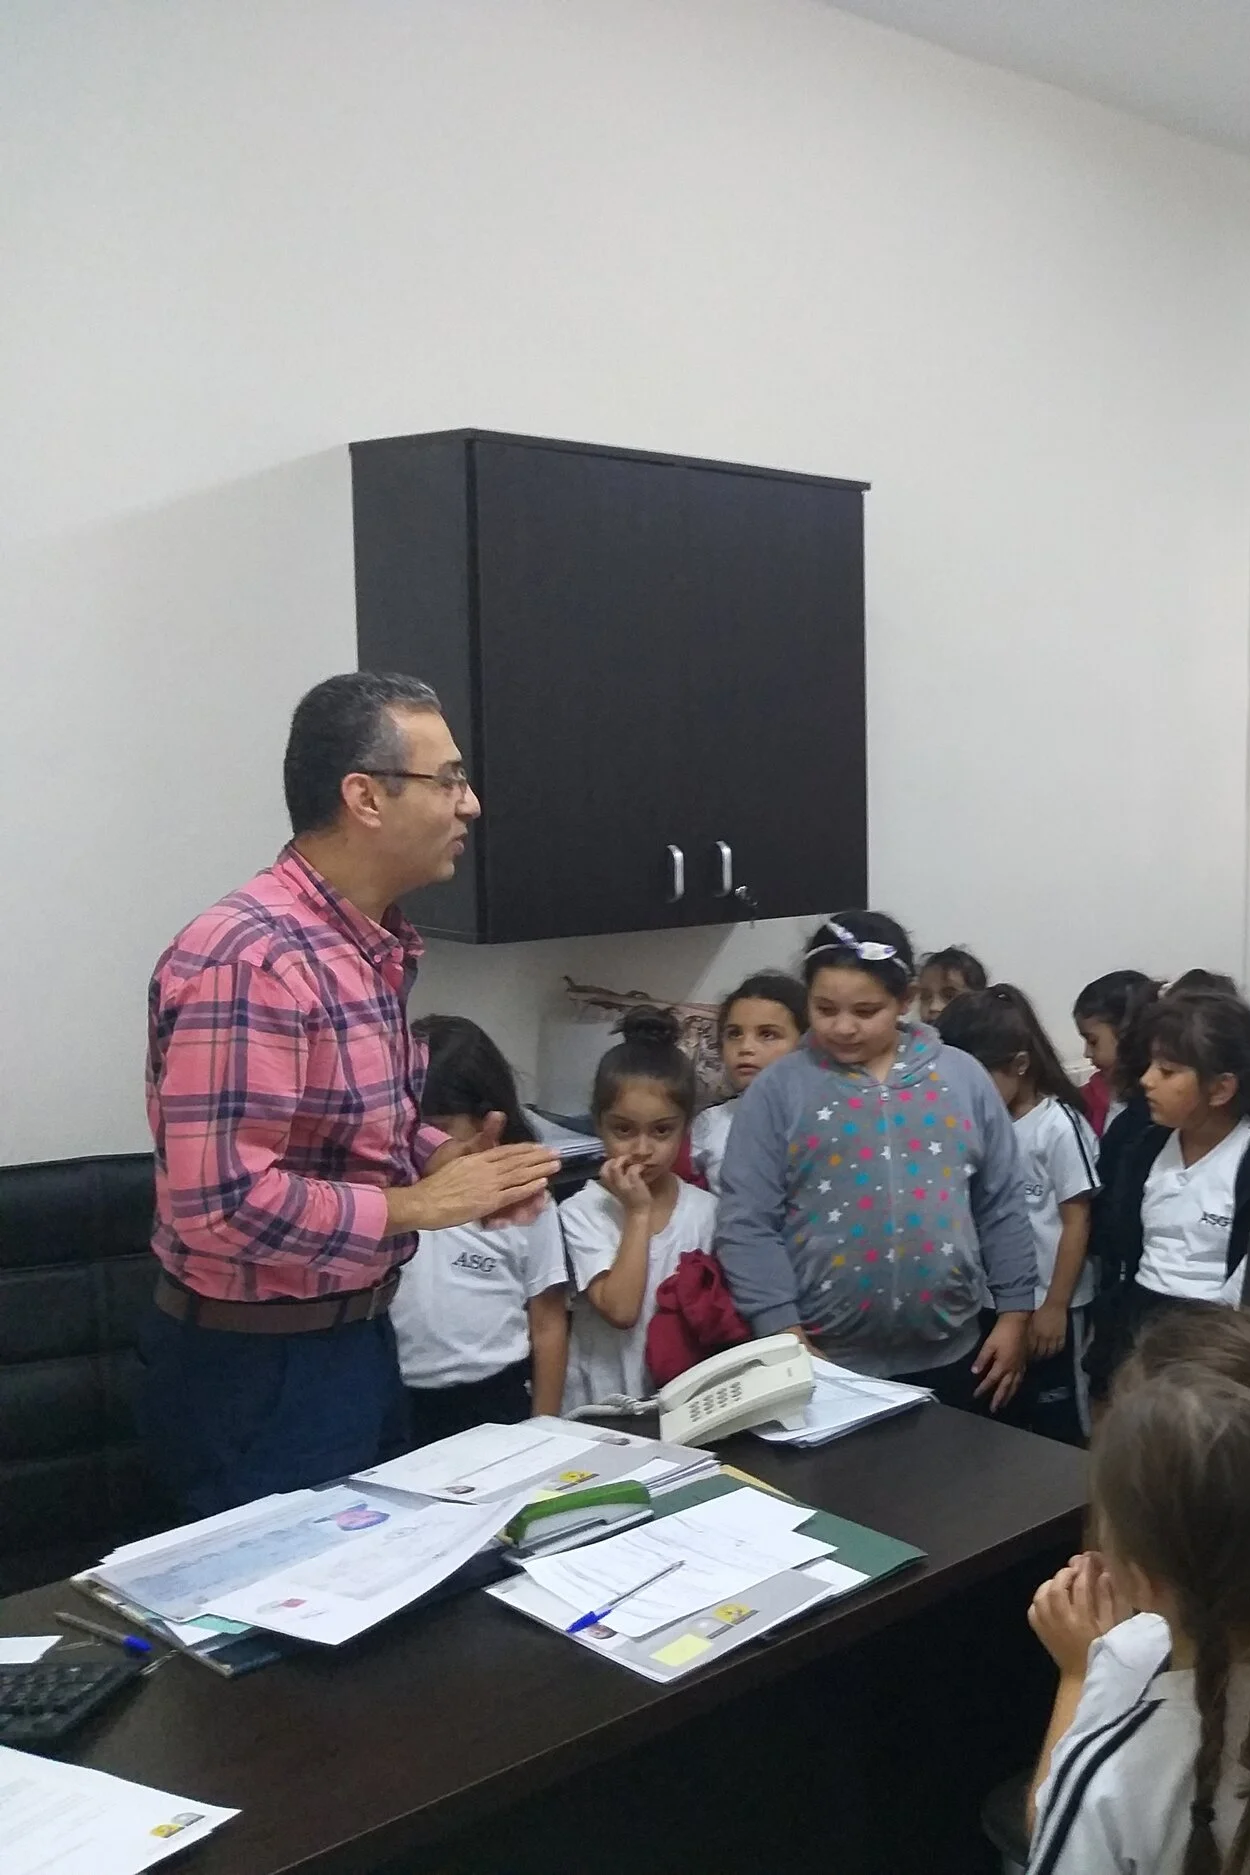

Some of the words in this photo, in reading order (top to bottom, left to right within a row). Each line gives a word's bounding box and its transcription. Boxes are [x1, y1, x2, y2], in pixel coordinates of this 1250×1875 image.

[1023, 1184, 1044, 1197] SG
[1200, 1211, 1232, 1227] ASG
[451, 1251, 497, 1273] ASG
